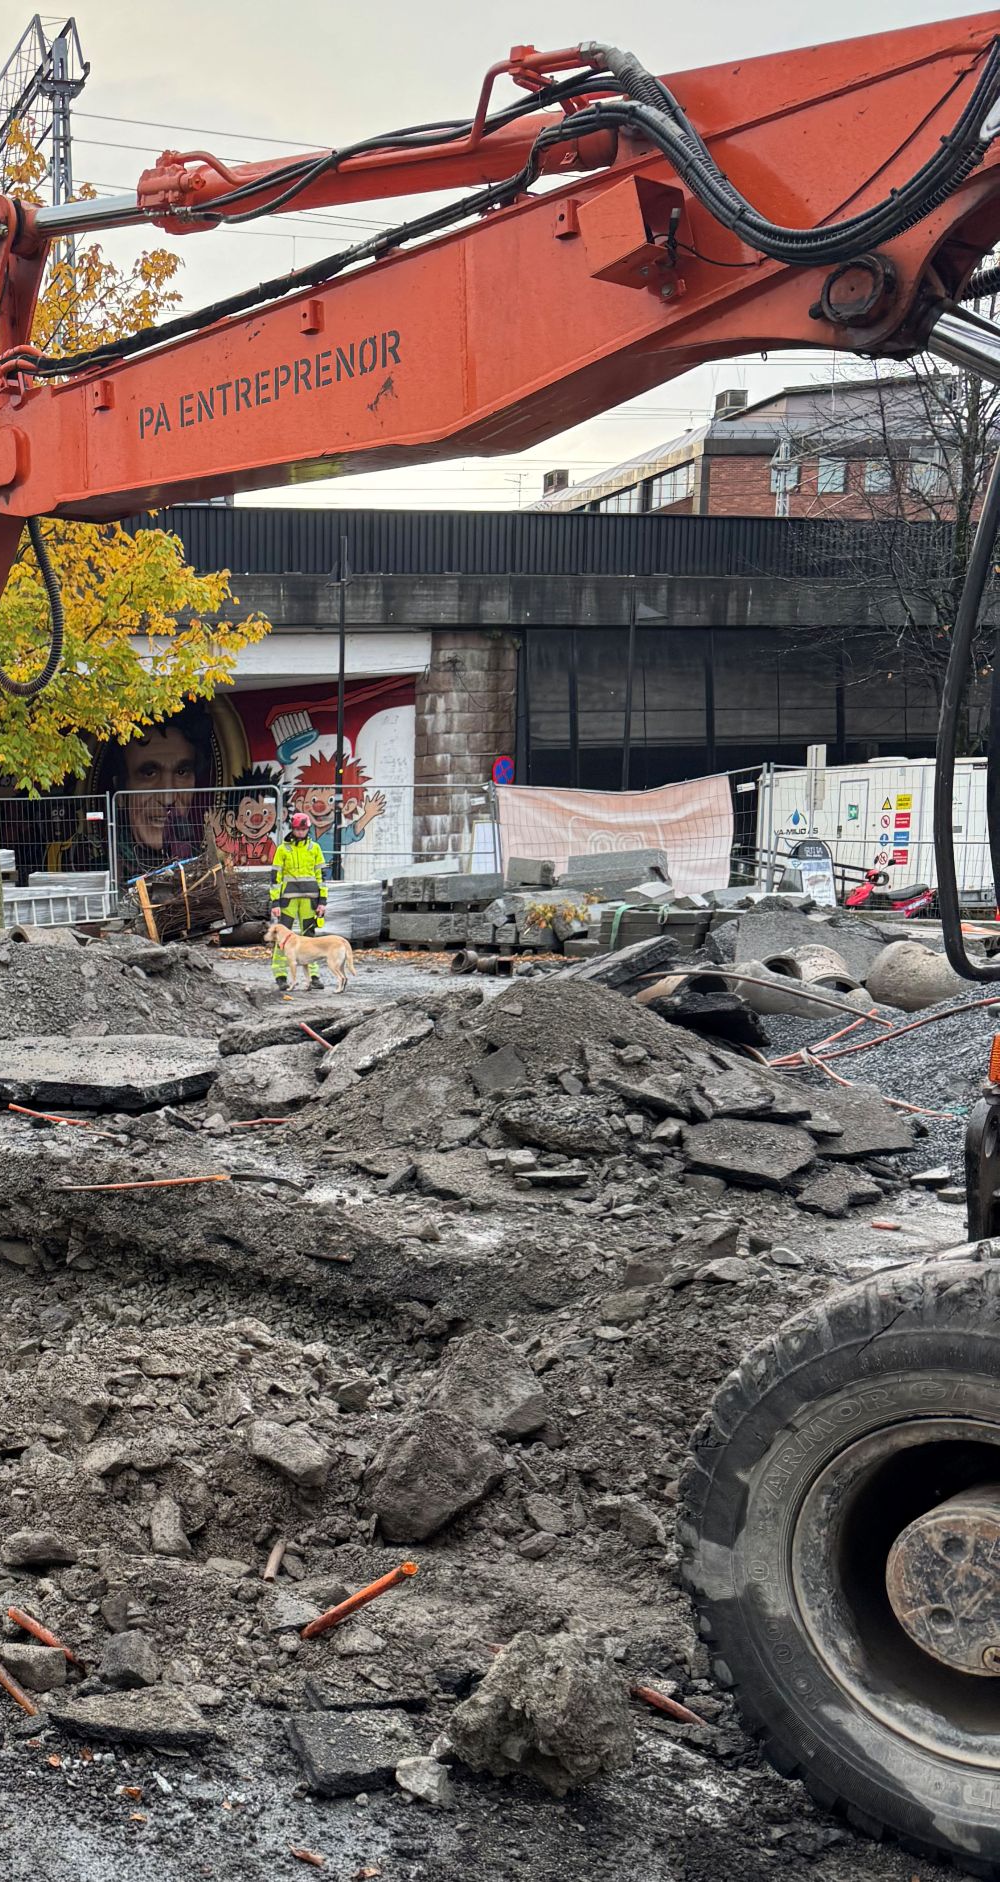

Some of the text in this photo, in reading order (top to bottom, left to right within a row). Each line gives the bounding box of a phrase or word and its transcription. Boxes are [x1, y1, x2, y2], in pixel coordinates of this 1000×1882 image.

[138, 329, 401, 439] PA ENTREPRENØR
[763, 1389, 897, 1499] ARMOR
